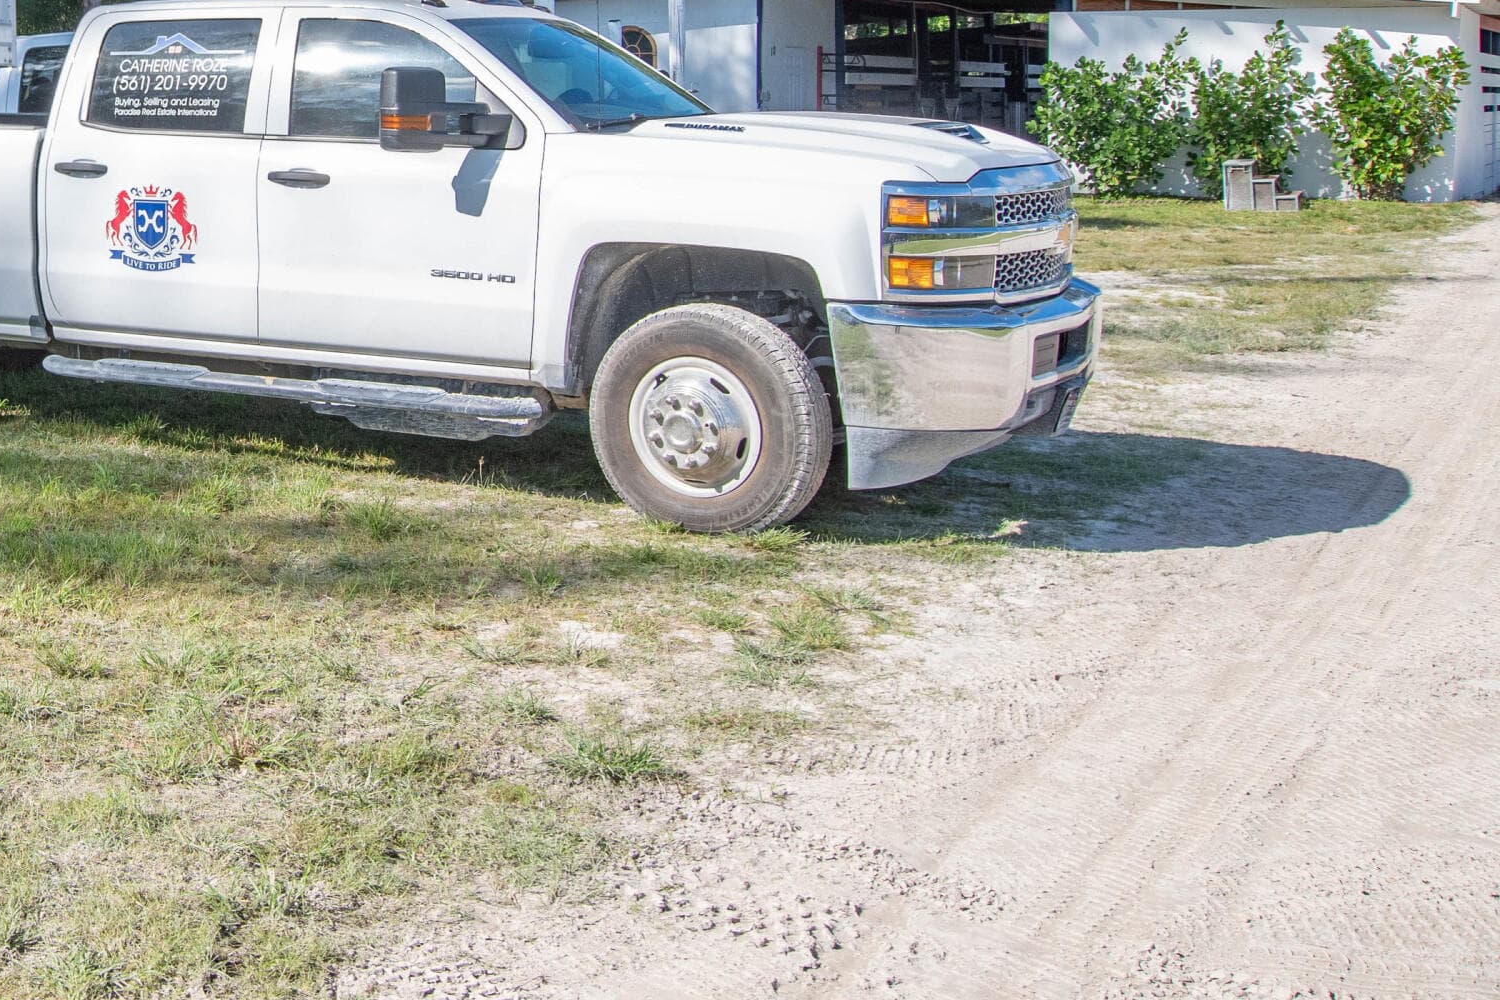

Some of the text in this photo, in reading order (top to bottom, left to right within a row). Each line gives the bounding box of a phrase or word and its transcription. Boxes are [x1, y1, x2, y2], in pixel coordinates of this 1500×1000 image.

[120, 58, 228, 73] CATHERINE ROZE
[113, 74, 228, 94] (561) 201-9970
[143, 97, 169, 108] Selling
[170, 96, 188, 106] and
[189, 96, 220, 108] Leasing
[114, 108, 218, 116] Paradise Real Estate International
[686, 123, 746, 132] DURAMAX
[126, 257, 144, 269] LIVE
[157, 261, 177, 270] RIDE
[430, 268, 516, 284] 3500 HD
